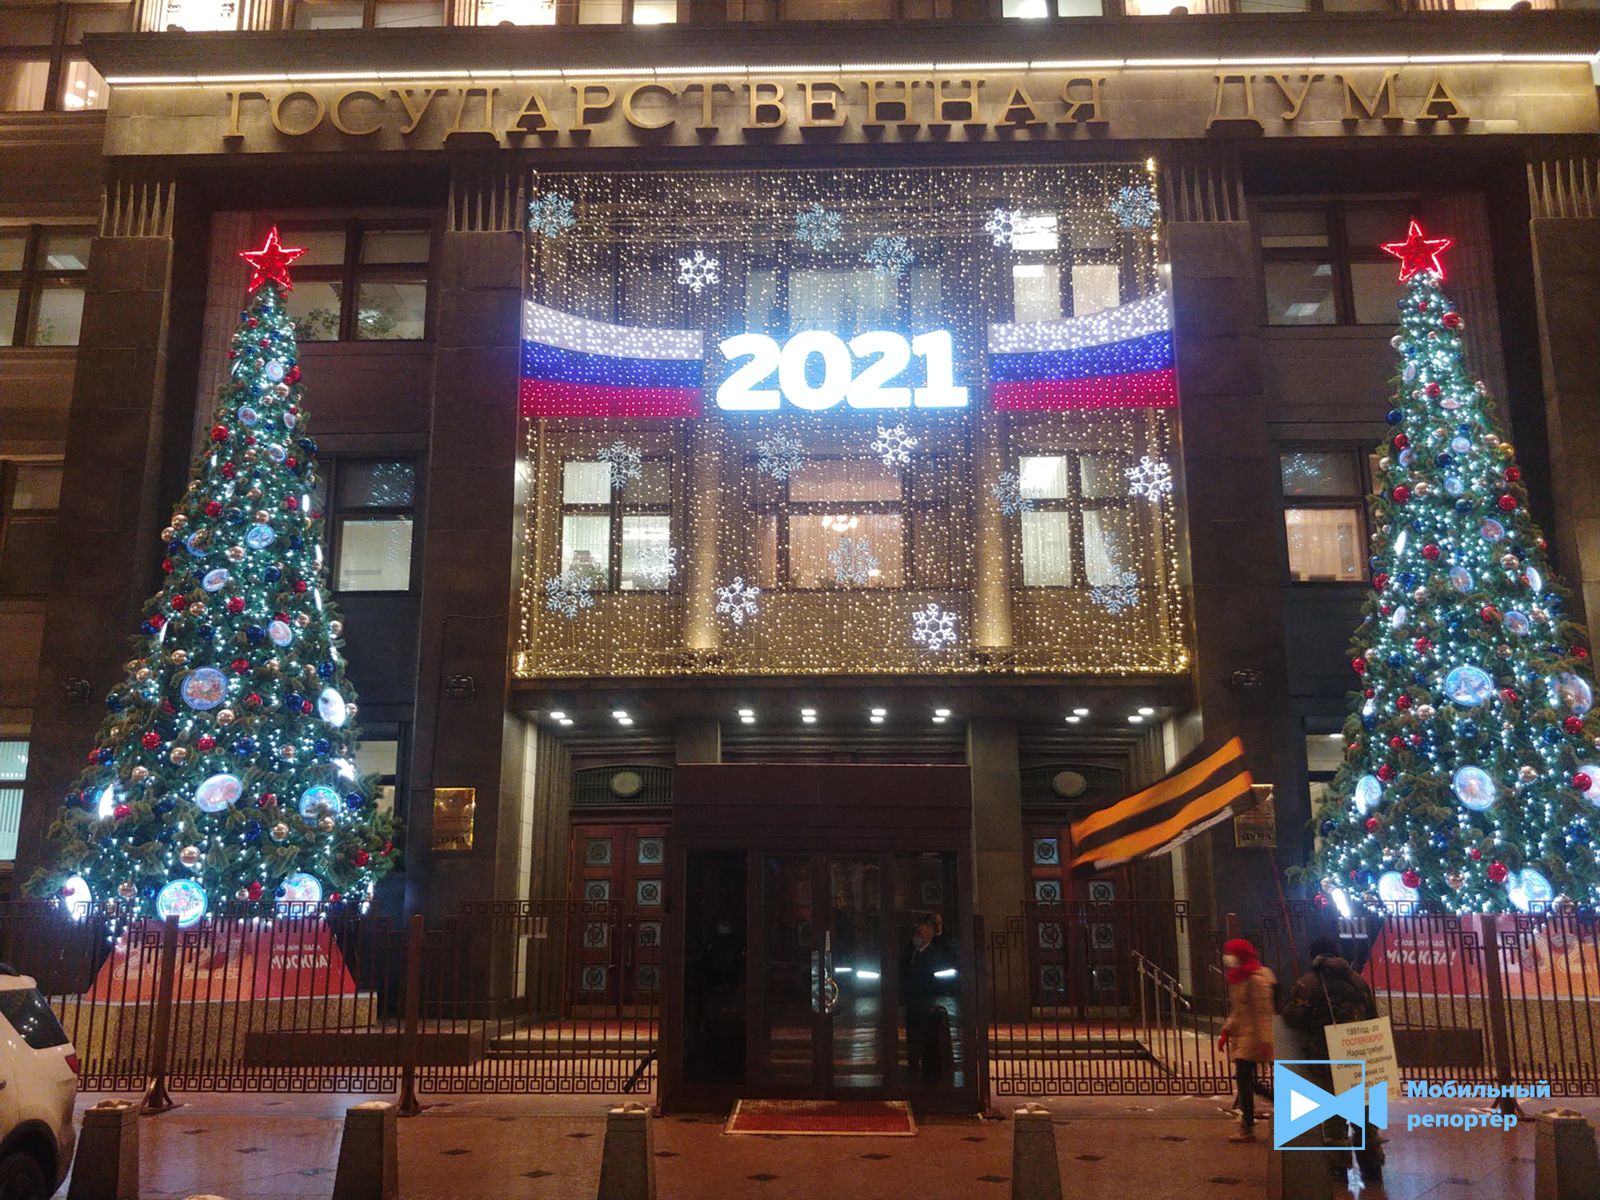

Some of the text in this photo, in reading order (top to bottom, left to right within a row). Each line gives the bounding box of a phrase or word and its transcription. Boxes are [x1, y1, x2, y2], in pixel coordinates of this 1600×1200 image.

[222, 71, 1470, 143] ГОСУДАРСТВЕННАЯ ДУМА
[716, 330, 969, 411] 2021
[1386, 949, 1457, 966] МОСКВА!
